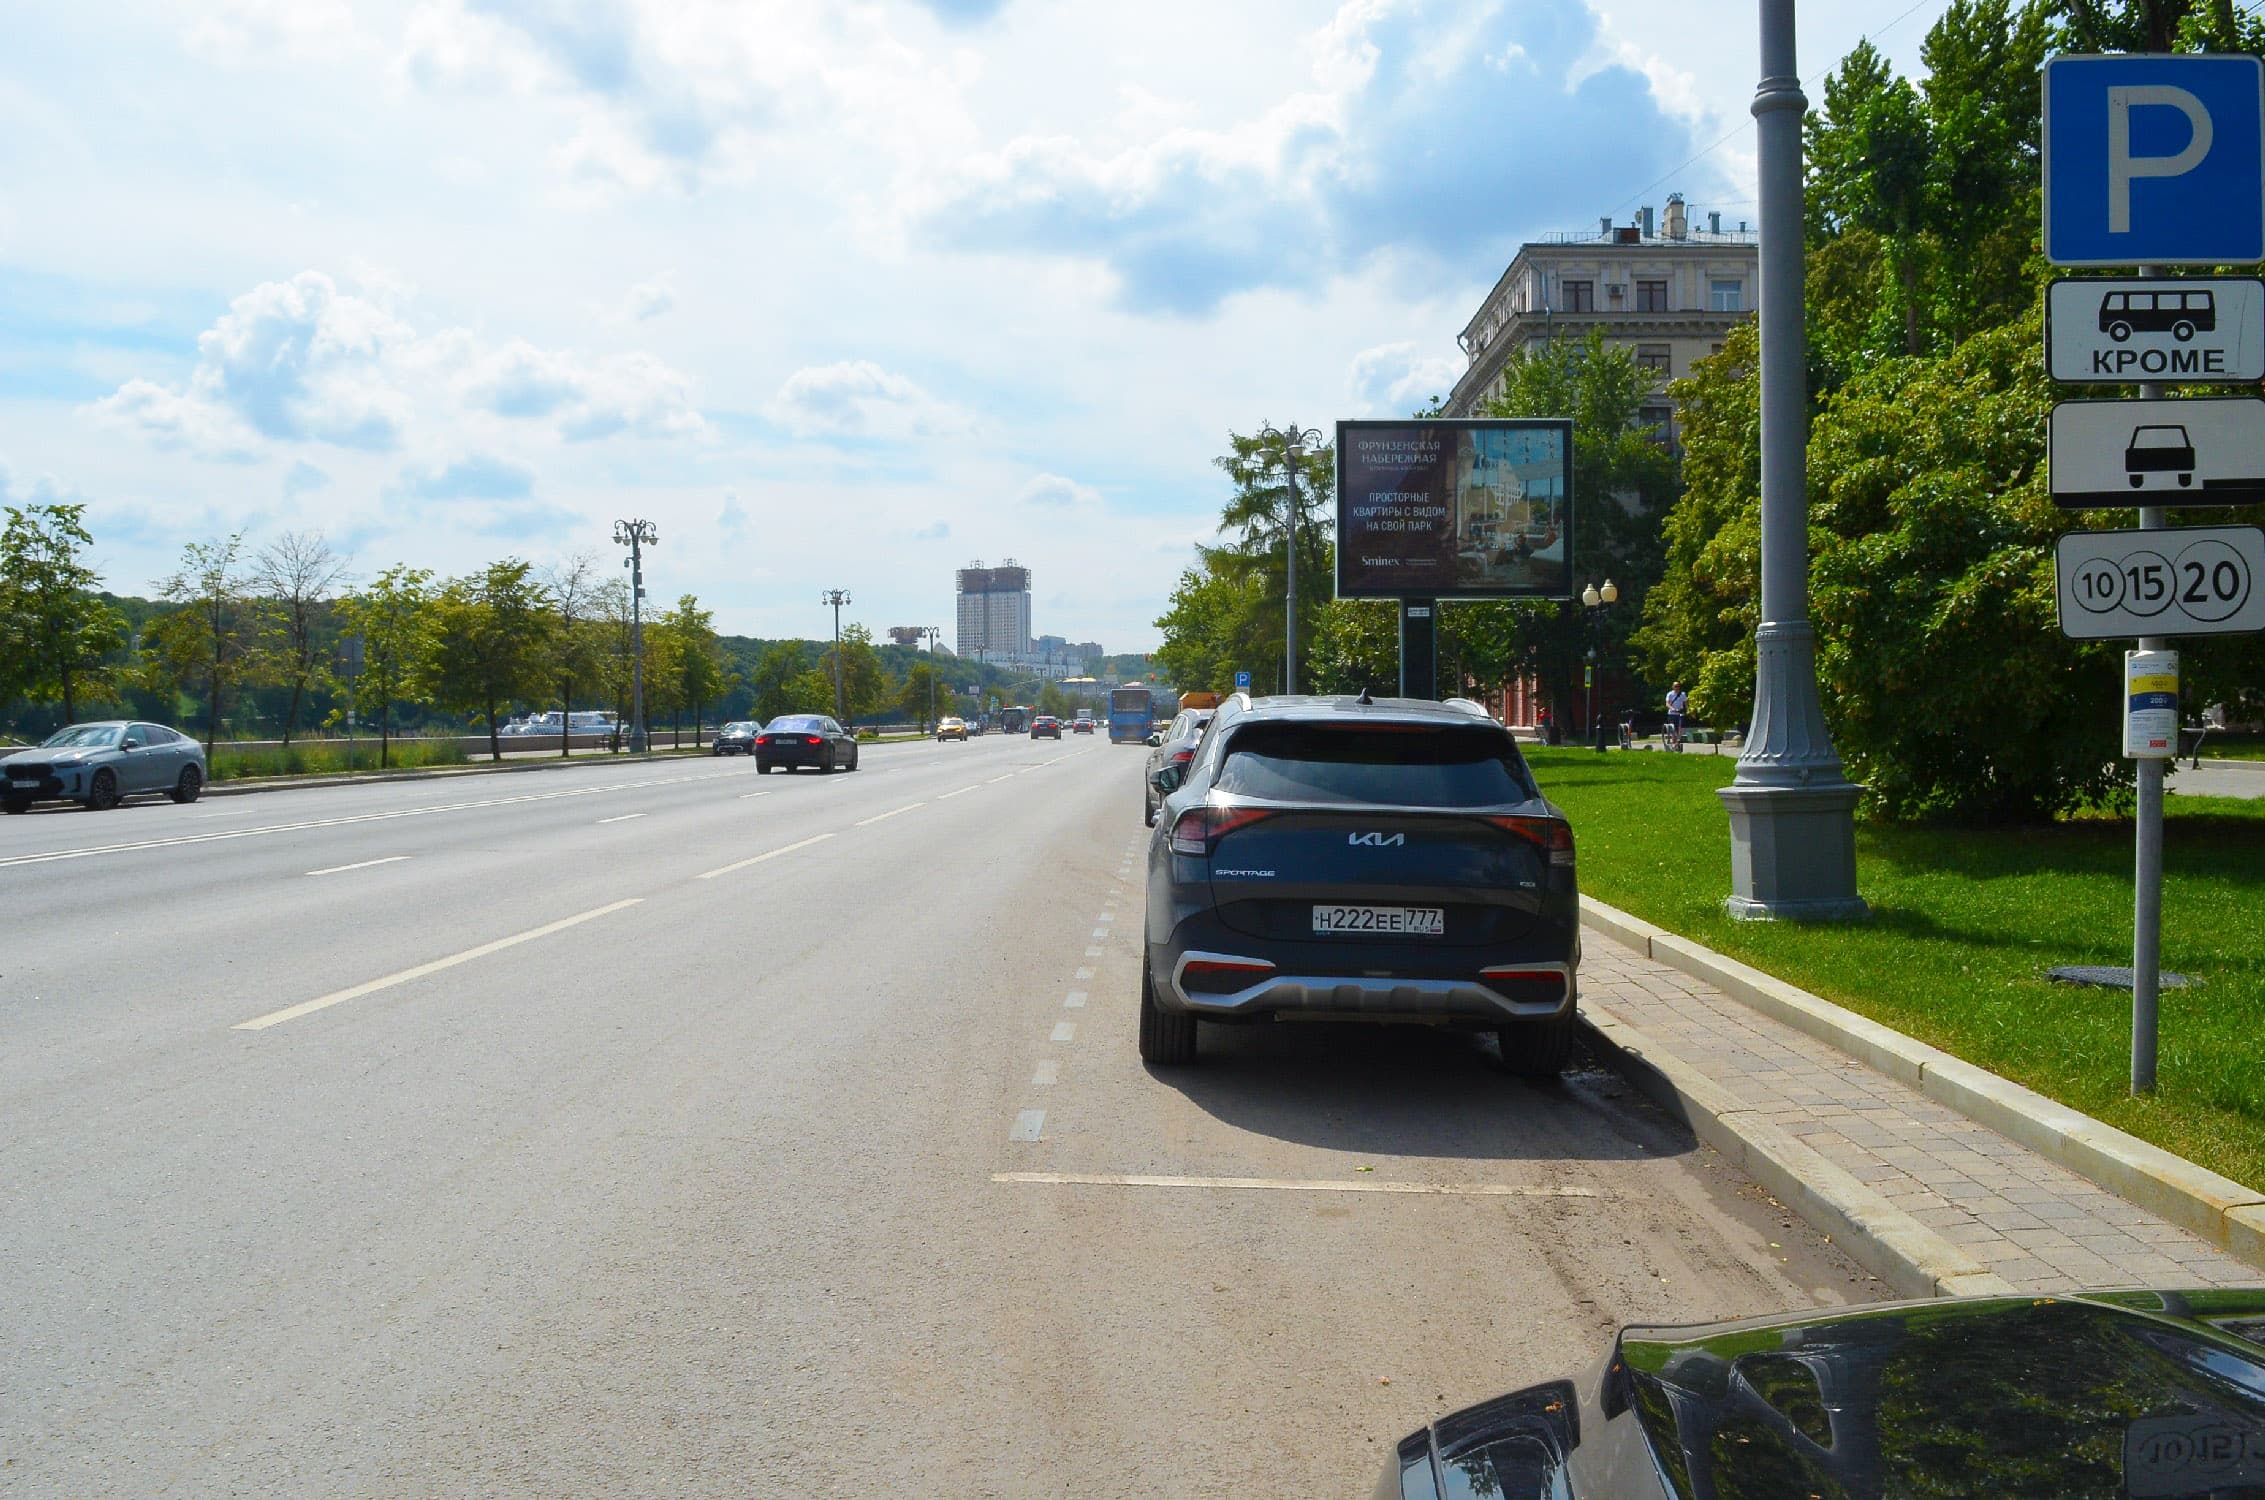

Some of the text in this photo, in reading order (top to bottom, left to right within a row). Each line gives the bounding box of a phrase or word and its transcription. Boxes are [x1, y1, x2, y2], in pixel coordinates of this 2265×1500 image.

[2107, 84, 2214, 233] P
[2092, 348, 2225, 375] КРОМЕ
[1358, 440, 1441, 451] ФРУНЗЕНСКАЯ
[1361, 453, 1438, 464] НАБЕРЕЖНАЯ
[1369, 492, 1430, 503] ПРОСТОРНЫЕ
[1353, 506, 1446, 518] КВАРТИРЫ С ВИДОМ
[1366, 518, 1432, 531] НА СВОЙ ПАРК
[1361, 556, 1400, 566] Sminex
[2081, 560, 2240, 603] 10 15 20
[1239, 674, 1248, 685] P
[1349, 832, 1404, 846] KIA
[1215, 869, 1276, 877] SPORTAGE
[1407, 909, 1438, 926] 777
